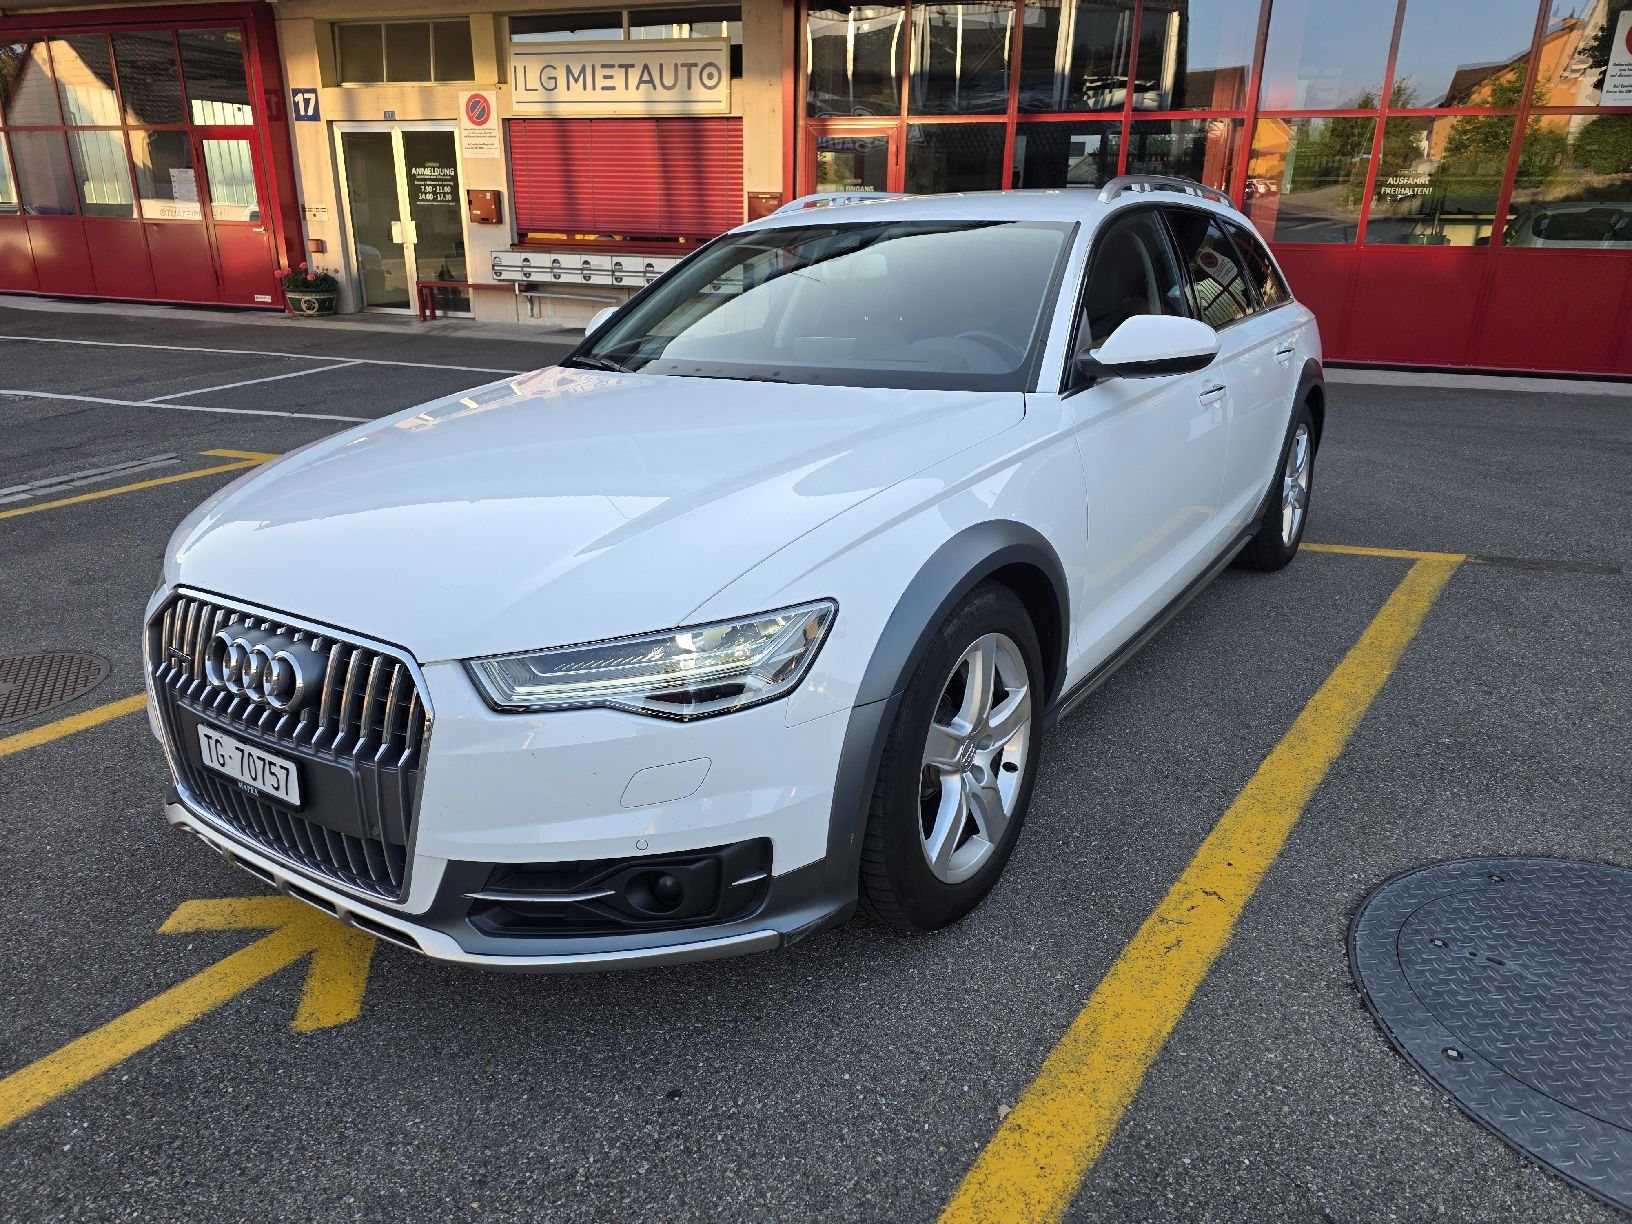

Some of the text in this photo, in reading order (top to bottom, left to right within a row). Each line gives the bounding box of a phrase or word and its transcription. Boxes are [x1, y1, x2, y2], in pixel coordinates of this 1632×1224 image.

[513, 62, 722, 92] ILG MIETAUTO
[294, 93, 315, 116] 17
[1381, 187, 1432, 195] FREIHALTEN!
[1387, 177, 1431, 185] AUSFAHRT
[203, 733, 225, 767] TG
[234, 746, 290, 796] 70757
